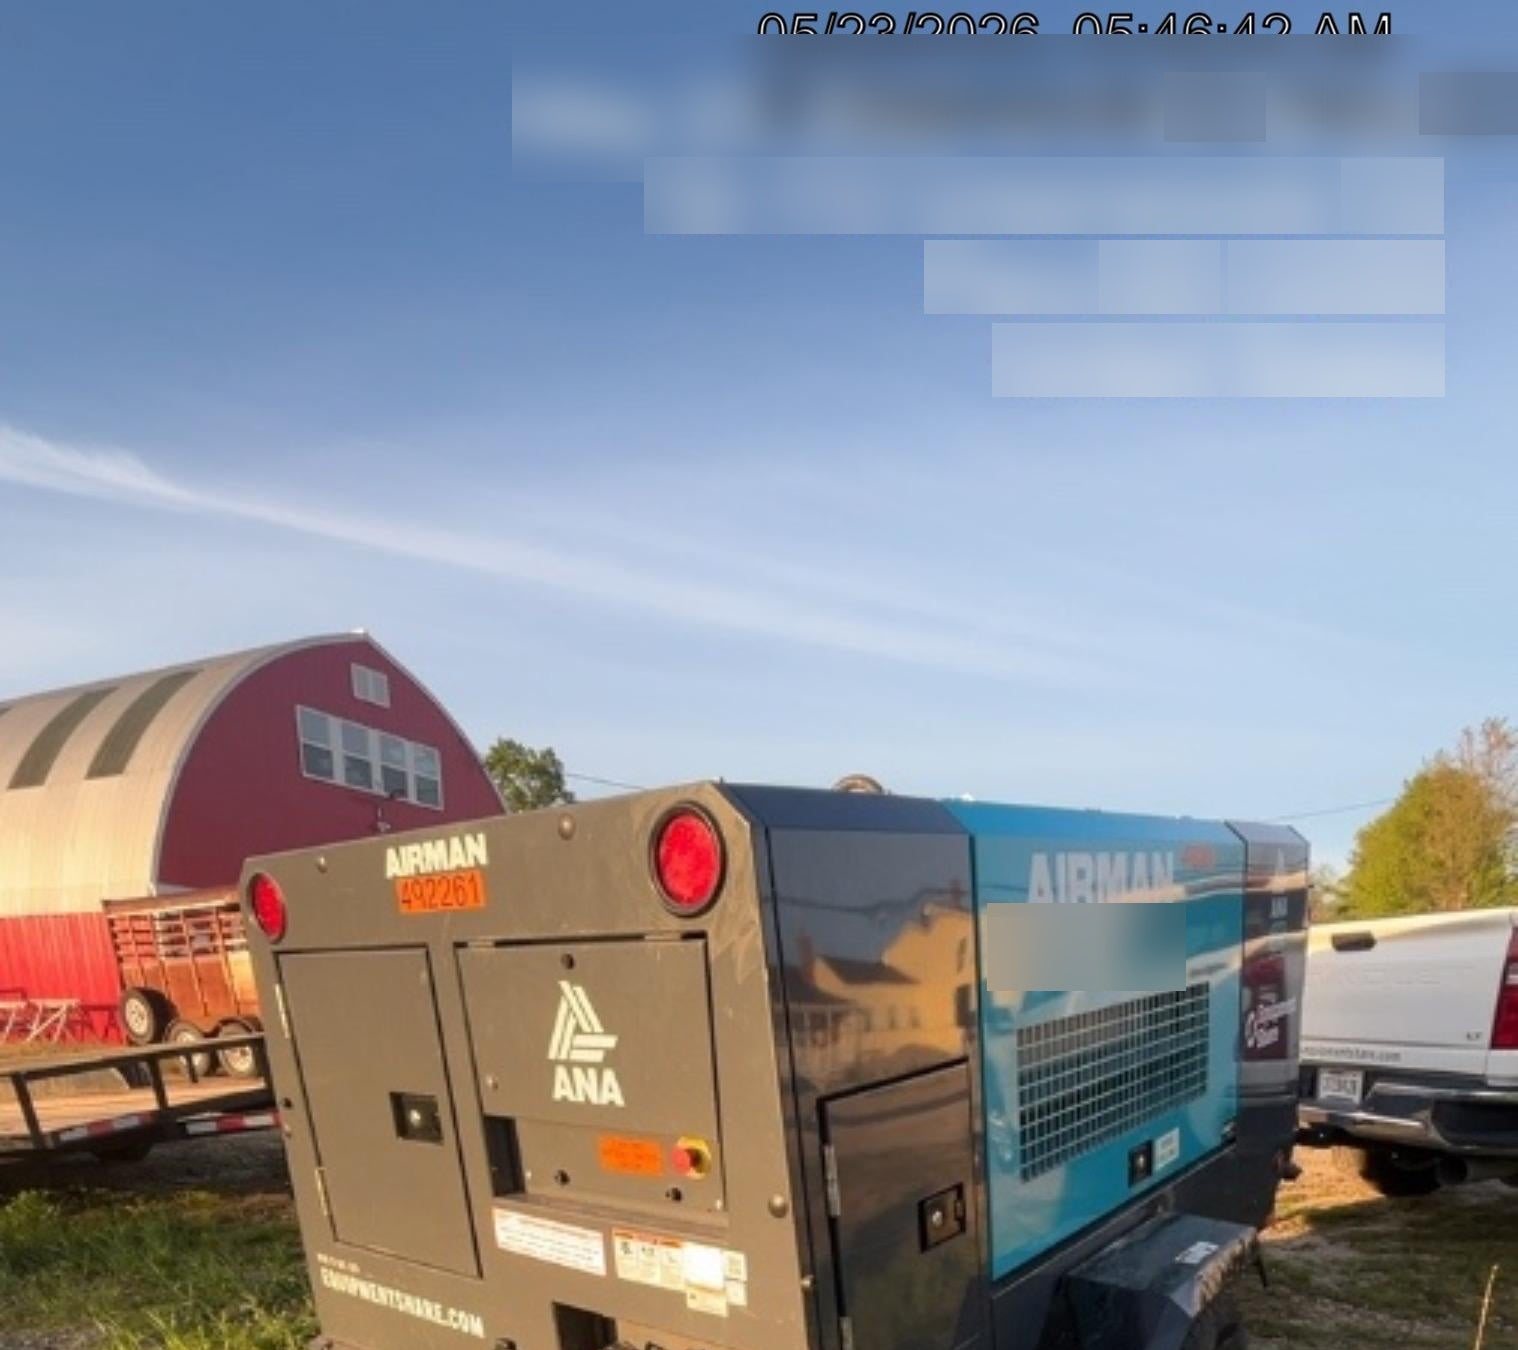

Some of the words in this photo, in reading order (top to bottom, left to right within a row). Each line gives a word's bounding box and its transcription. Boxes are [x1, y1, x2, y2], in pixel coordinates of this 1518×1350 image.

[386, 832, 487, 880] AIRMAN
[1029, 851, 1174, 903] AIRMAN
[401, 872, 480, 909] 492261
[552, 1064, 625, 1107] ANA
